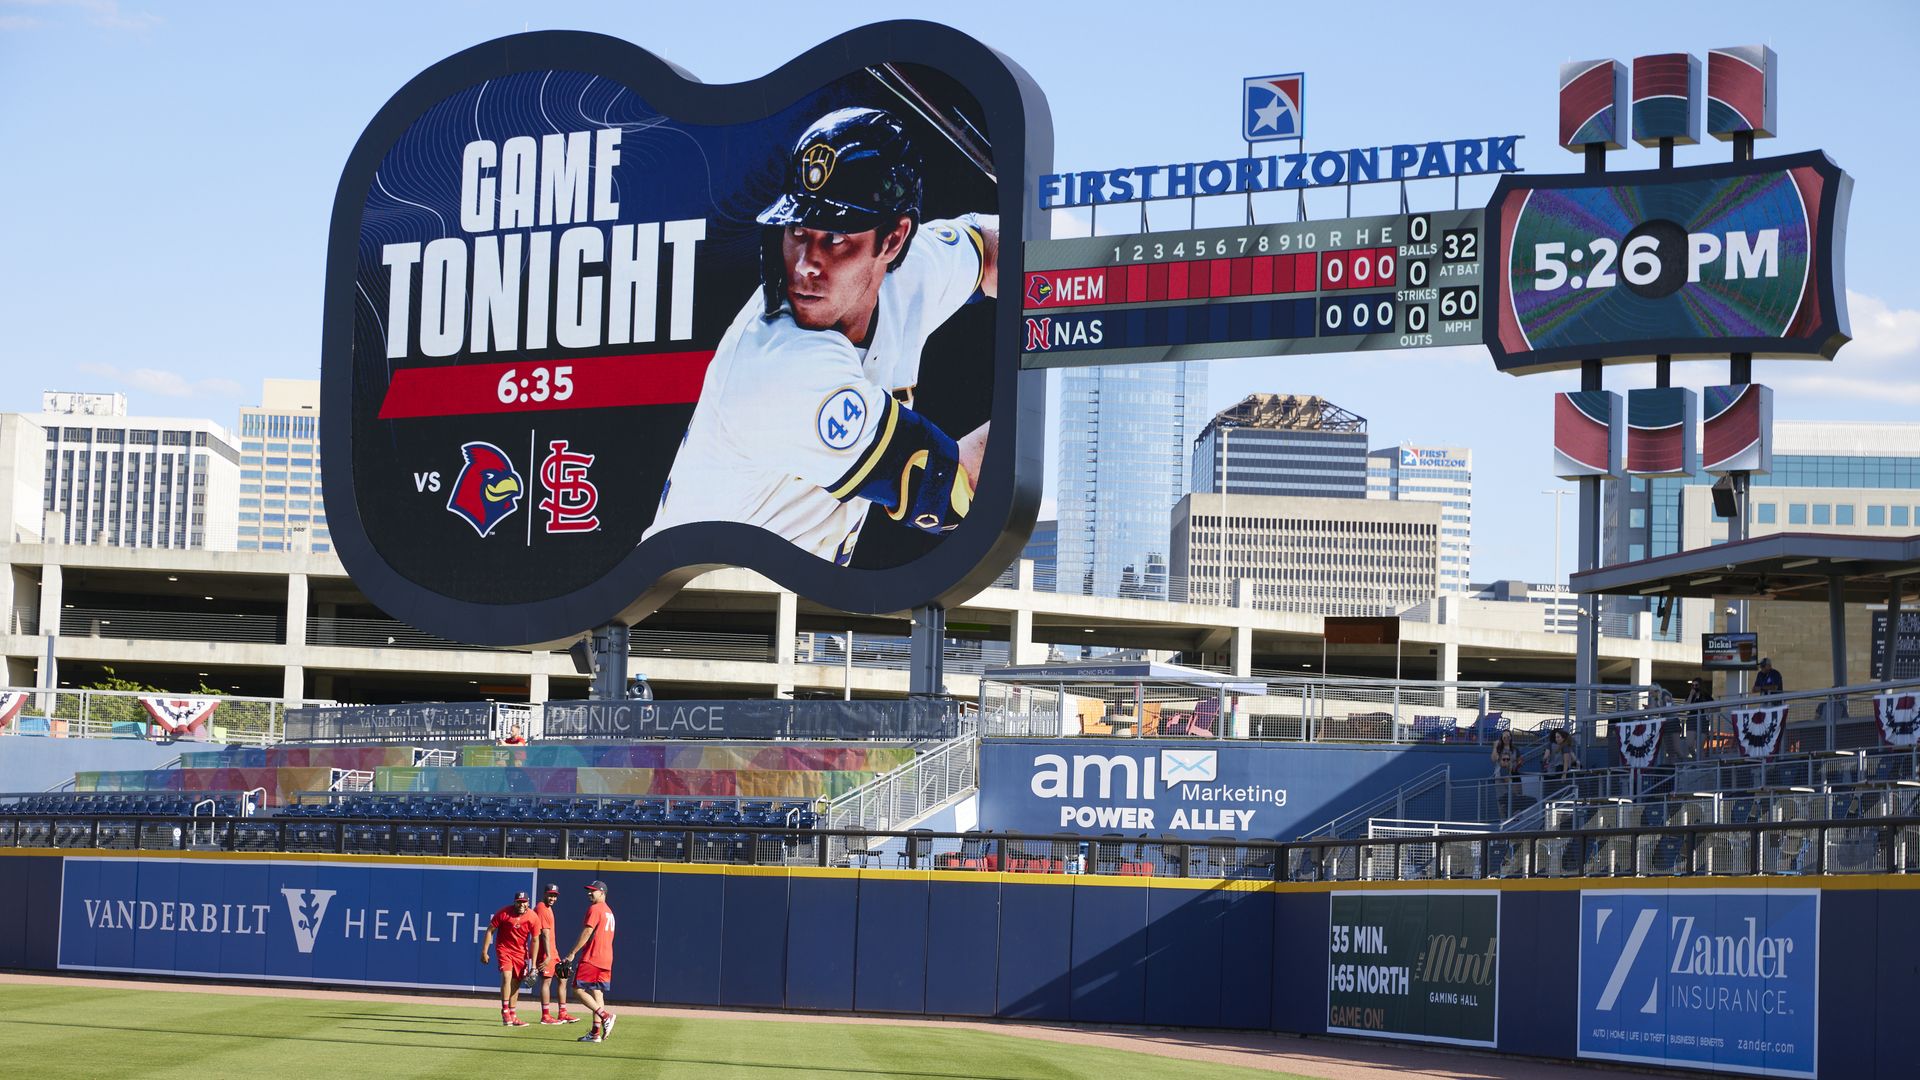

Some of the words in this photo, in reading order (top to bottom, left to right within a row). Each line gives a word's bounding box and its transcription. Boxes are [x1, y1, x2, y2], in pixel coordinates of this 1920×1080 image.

[460, 127, 622, 233] GAME
[1039, 165, 1160, 210] FIRST
[1168, 146, 1380, 198] HORIZON
[1391, 135, 1519, 180] PARK
[1410, 216, 1428, 241] 0
[1114, 246, 1120, 262] 1
[1133, 245, 1143, 260] 2
[1153, 243, 1164, 259] 3
[1173, 242, 1185, 258] 4
[1195, 241, 1206, 256] 5
[1215, 239, 1227, 255] 6
[1237, 238, 1248, 253] 7
[1258, 236, 1269, 252] 8
[1279, 234, 1290, 250] 9
[1296, 232, 1316, 249] 10
[1330, 231, 1342, 247] R
[1356, 228, 1369, 245] H
[1381, 227, 1392, 243] E
[1399, 243, 1438, 257] BALLS
[1444, 233, 1476, 259] 32
[1440, 265, 1455, 277] AT
[1457, 263, 1480, 276] BAT
[1534, 235, 1662, 292] 5:26
[1686, 228, 1779, 283] PM
[1056, 275, 1104, 302] MEM
[1327, 258, 1343, 283] 0
[1354, 256, 1370, 281] 0
[1378, 254, 1394, 279] 0
[1409, 261, 1427, 286] 0
[382, 218, 706, 359] TONIGHT
[1397, 288, 1438, 302] STRIKES
[1441, 290, 1477, 316] 60
[1055, 319, 1103, 346] NAS
[1326, 304, 1342, 329] 0
[1353, 302, 1369, 327] 0
[1377, 301, 1393, 326] 0
[1408, 306, 1426, 331] 0
[1445, 321, 1472, 333] MPH
[1400, 334, 1433, 347] OUTS
[497, 366, 574, 404] 6:35
[827, 397, 863, 440] 44
[1419, 449, 1448, 458] FIRST
[1419, 458, 1466, 467] HORIZON
[1708, 640, 1732, 649] Dickel
[360, 715, 419, 728] VANDERBILT
[551, 706, 631, 731] PICNIC
[639, 706, 725, 731] PLACE
[1030, 753, 1155, 800] ami
[1182, 783, 1287, 806] Marketing
[1060, 805, 1155, 829] POWER
[1168, 808, 1256, 831] ALLEY
[84, 899, 271, 935] VANDERBILT
[604, 912, 615, 932] 70
[1331, 925, 1349, 954] 35
[1353, 926, 1388, 955] MIN.
[1670, 916, 1794, 979] Zander
[1413, 951, 1426, 981] THE
[1422, 934, 1497, 986] Mint
[1330, 964, 1355, 993] I-65
[1357, 965, 1410, 995] NORTH
[1429, 991, 1458, 1005] GAMING
[1671, 985, 1787, 1015] INSURANCE
[1330, 1005, 1361, 1028] GAME
[1364, 1007, 1384, 1029] ON!
[1592, 1028, 1606, 1038] AUTO
[1609, 1029, 1625, 1040] HOME
[1629, 1031, 1639, 1041] LIFE
[1643, 1032, 1650, 1041] ID
[1650, 1033, 1665, 1042] THEFT
[1670, 1034, 1695, 1046] BUSINESS
[1700, 1037, 1724, 1048] BENEFITS
[1737, 1037, 1795, 1053] zander.com
